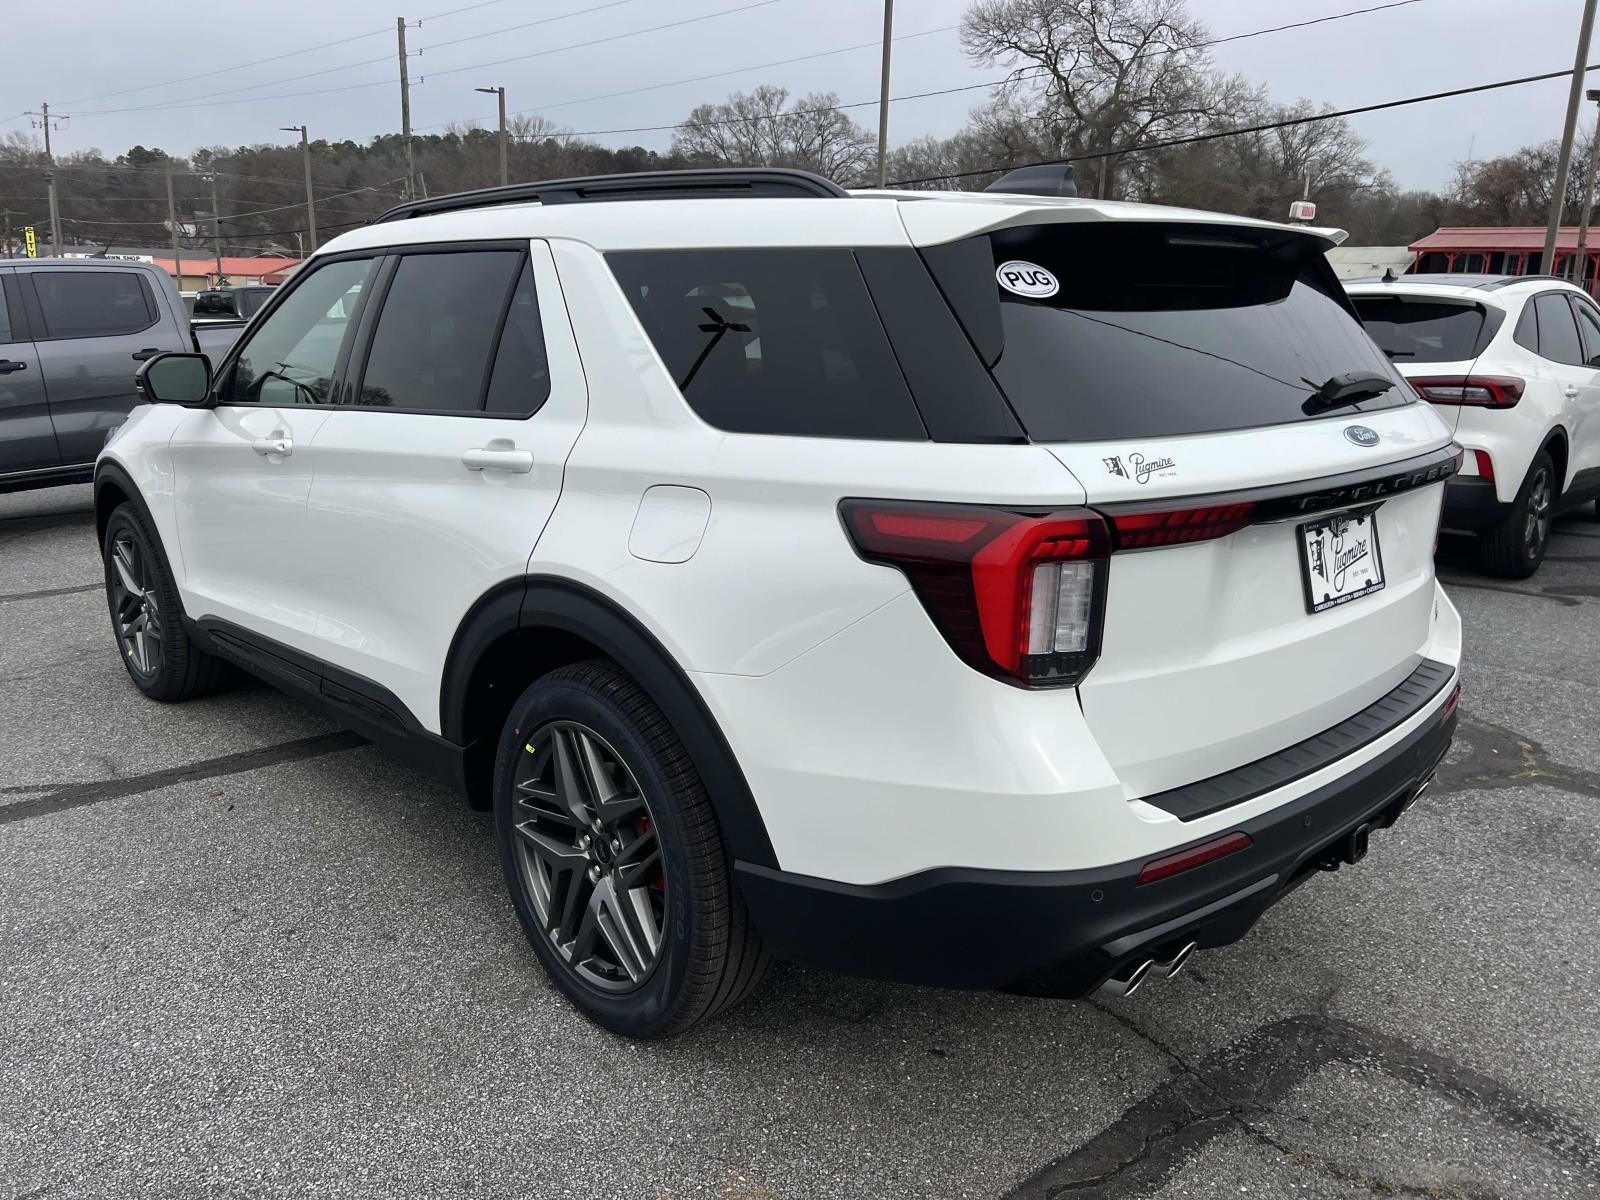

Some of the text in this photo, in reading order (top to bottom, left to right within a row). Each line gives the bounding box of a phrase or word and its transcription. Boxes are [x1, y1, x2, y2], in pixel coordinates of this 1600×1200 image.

[27, 228, 35, 256] CITY
[1003, 271, 1053, 287] PUG
[1354, 428, 1376, 441] Ford
[1128, 452, 1176, 485] Pugmire
[1330, 532, 1369, 593] Pugmire
